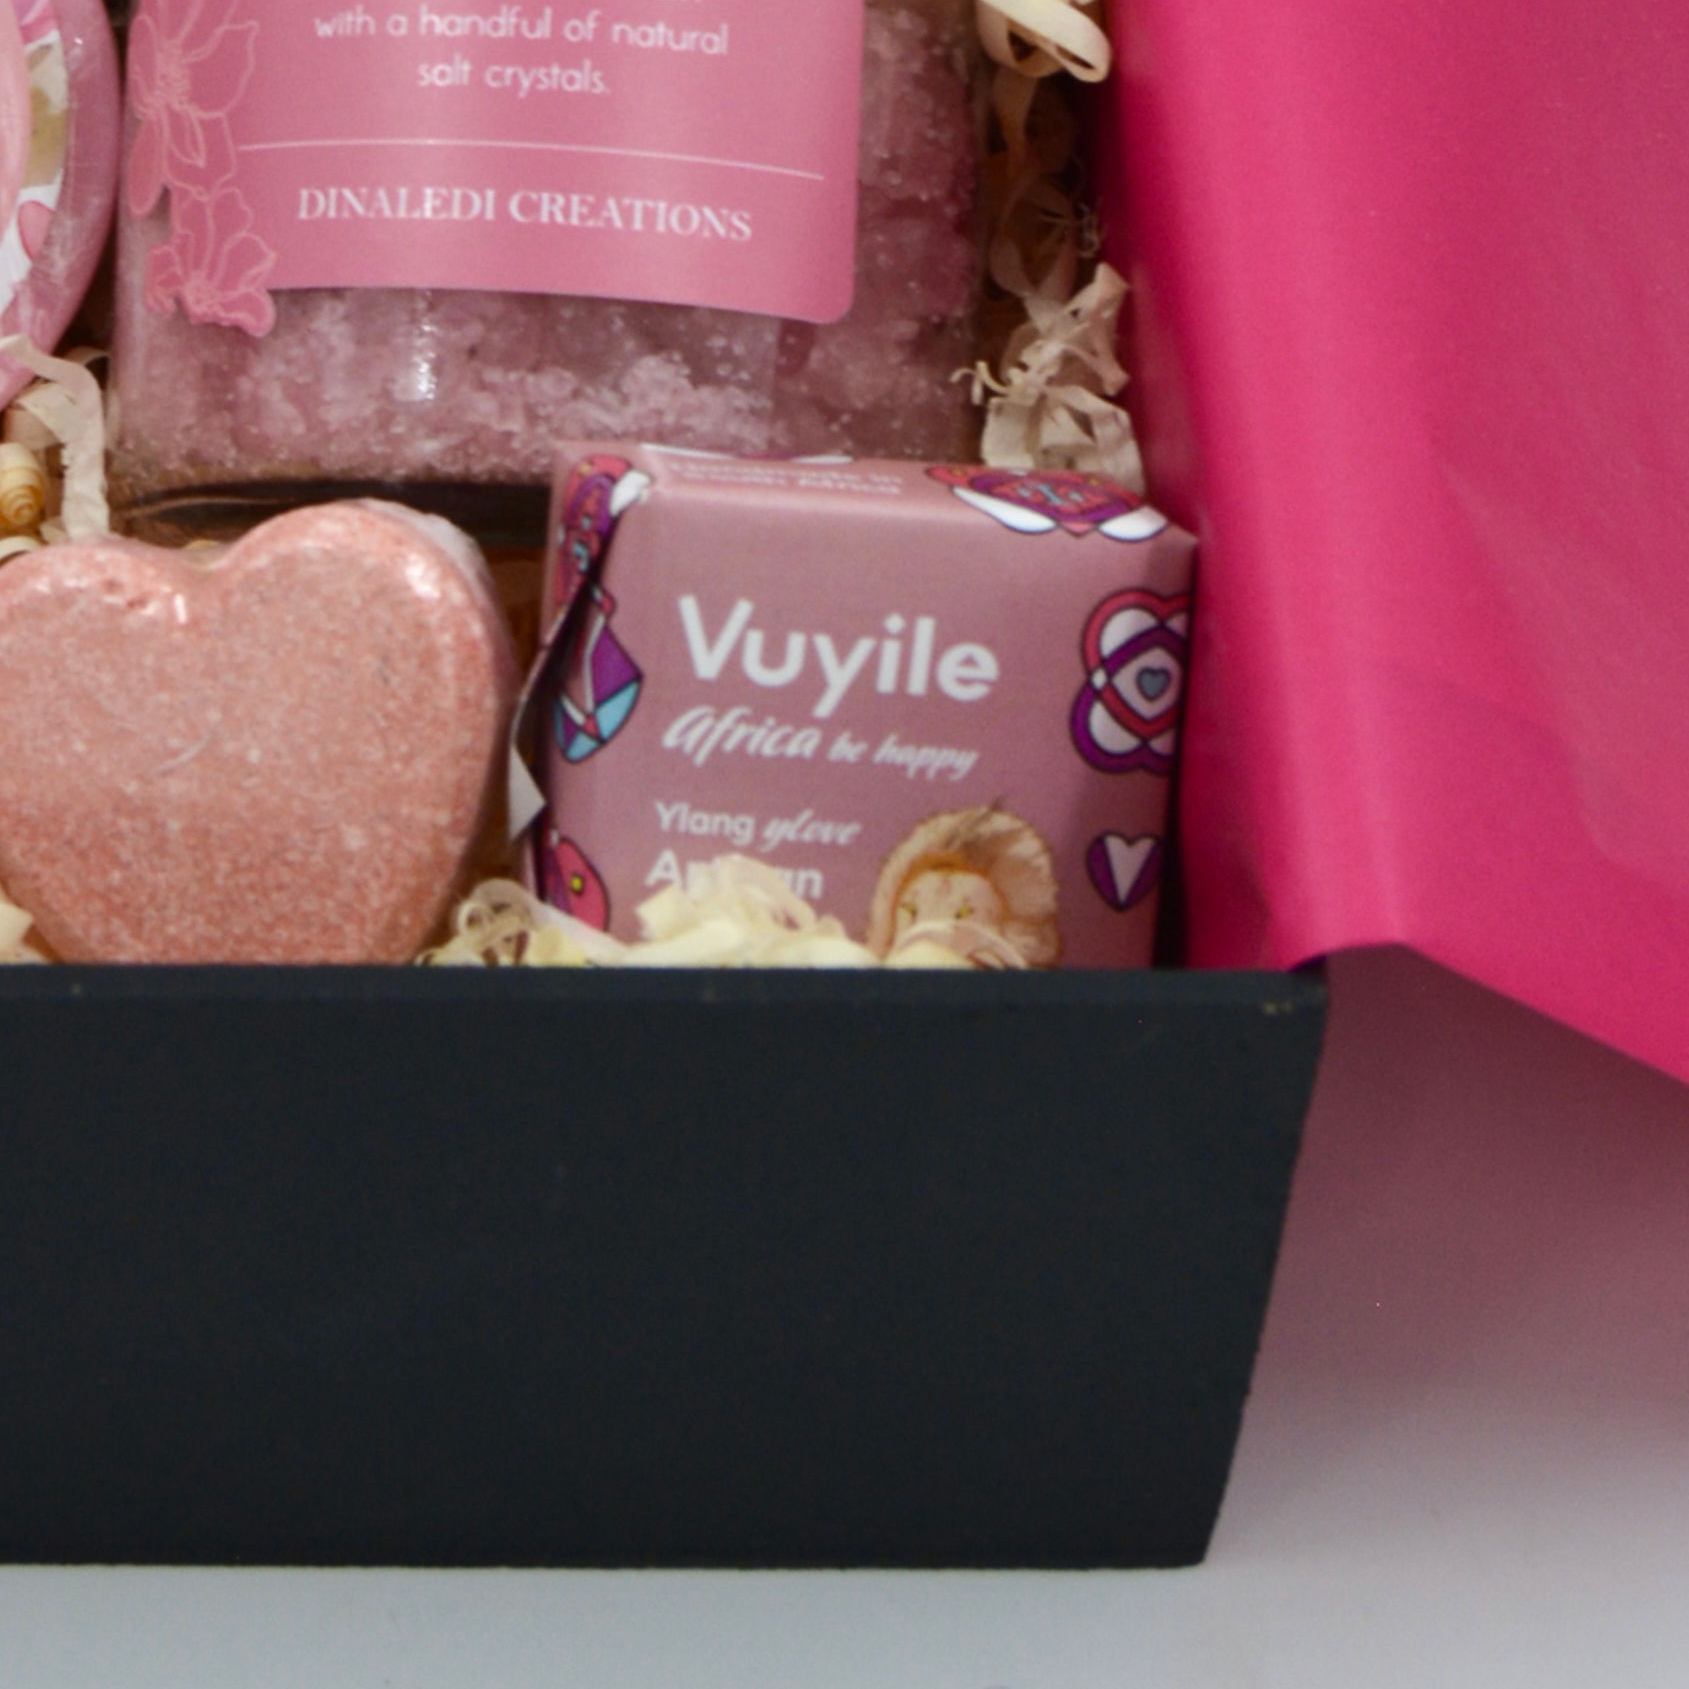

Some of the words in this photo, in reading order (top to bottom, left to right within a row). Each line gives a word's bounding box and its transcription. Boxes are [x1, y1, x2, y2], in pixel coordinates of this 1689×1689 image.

[314, 4, 375, 38] with
[386, 13, 408, 37] a
[419, 4, 552, 40] handful
[562, 10, 601, 42] of
[612, 22, 729, 56] natural
[417, 52, 473, 88] salt
[484, 58, 612, 98] crystals.
[297, 186, 496, 221] DINALEDI
[508, 190, 753, 242] CREATIONS
[677, 594, 1000, 719] Vuyile
[826, 730, 869, 764] be
[873, 733, 980, 782] happy
[654, 800, 756, 845] Ylang
